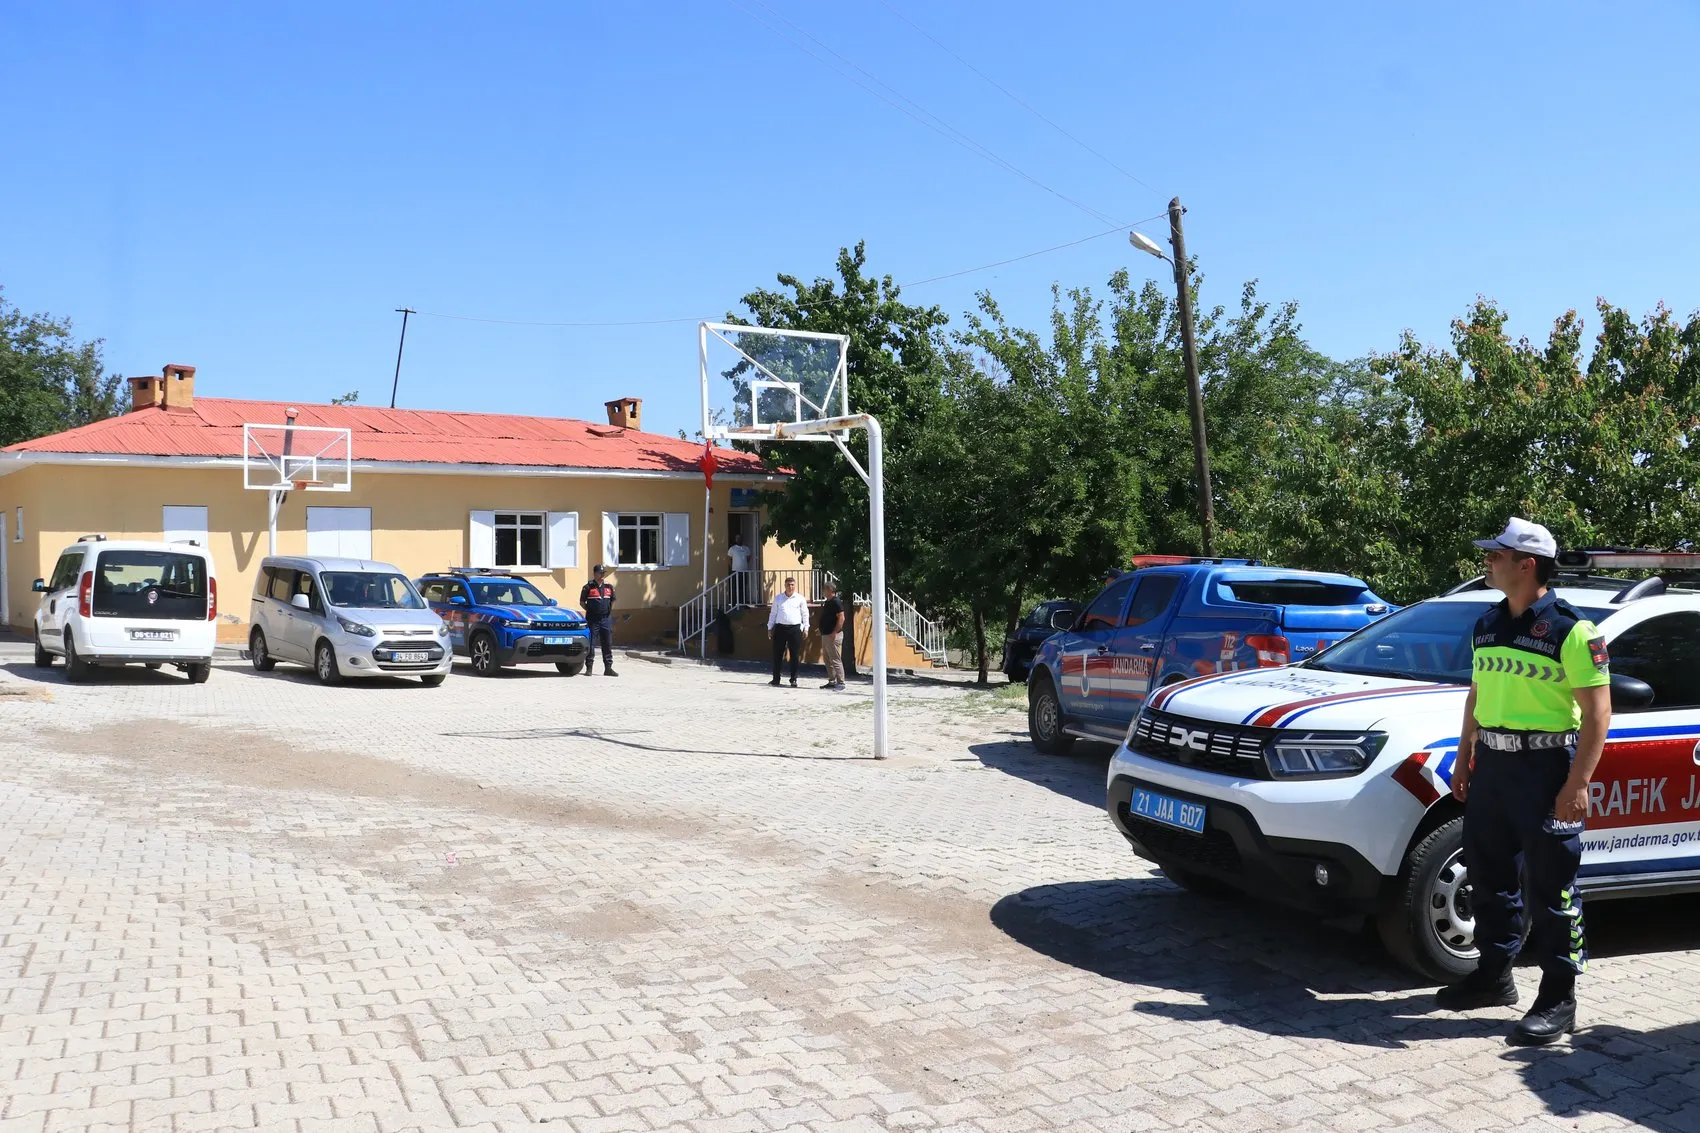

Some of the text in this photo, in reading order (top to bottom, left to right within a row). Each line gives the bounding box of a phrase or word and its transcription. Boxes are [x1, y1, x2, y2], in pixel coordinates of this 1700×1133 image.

[1224, 634, 1236, 649] 112
[1111, 658, 1149, 675] JANDARMA
[1136, 792, 1203, 828] 21 JAA 607
